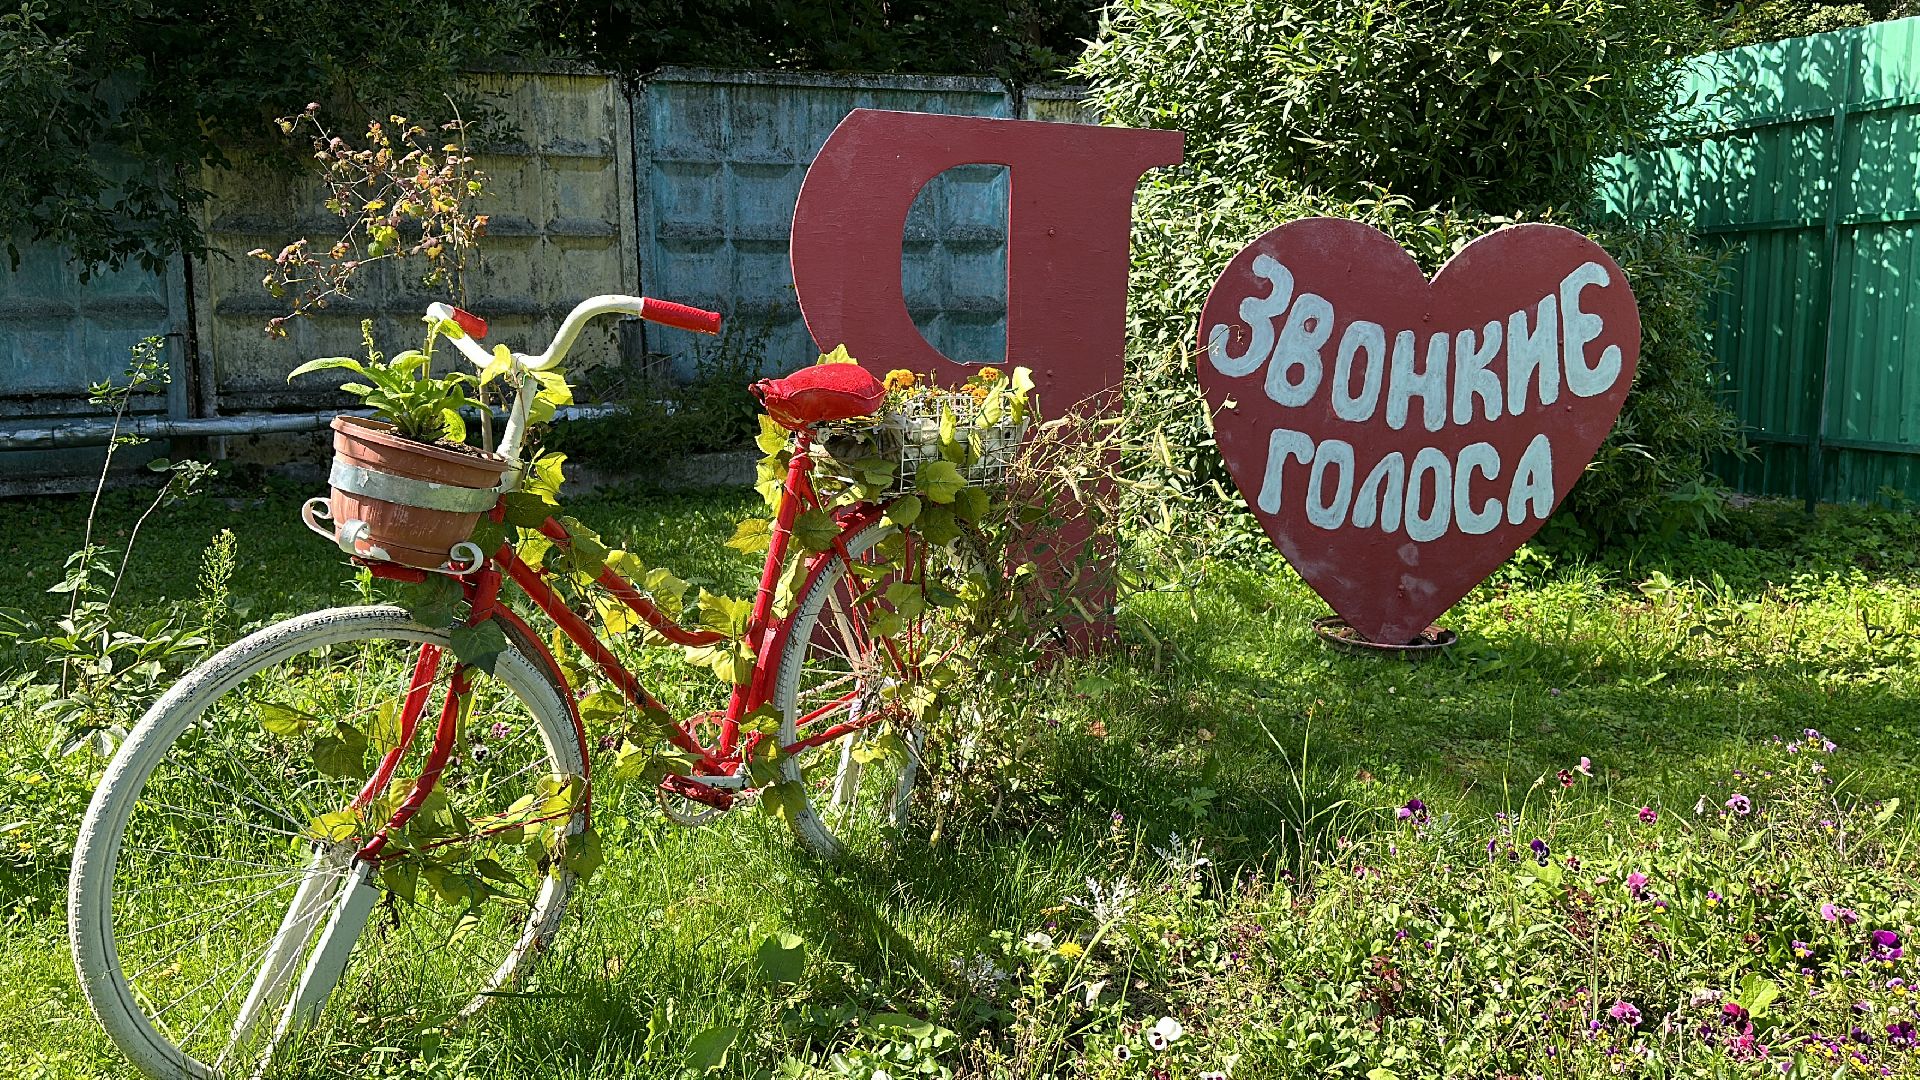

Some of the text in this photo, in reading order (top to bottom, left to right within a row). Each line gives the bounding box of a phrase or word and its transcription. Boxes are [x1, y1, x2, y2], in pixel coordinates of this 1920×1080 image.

[790, 108, 1184, 662] Я
[1208, 252, 1622, 433] ЗВОНКИЕ
[1257, 428, 1555, 542] ГОЛОСА
